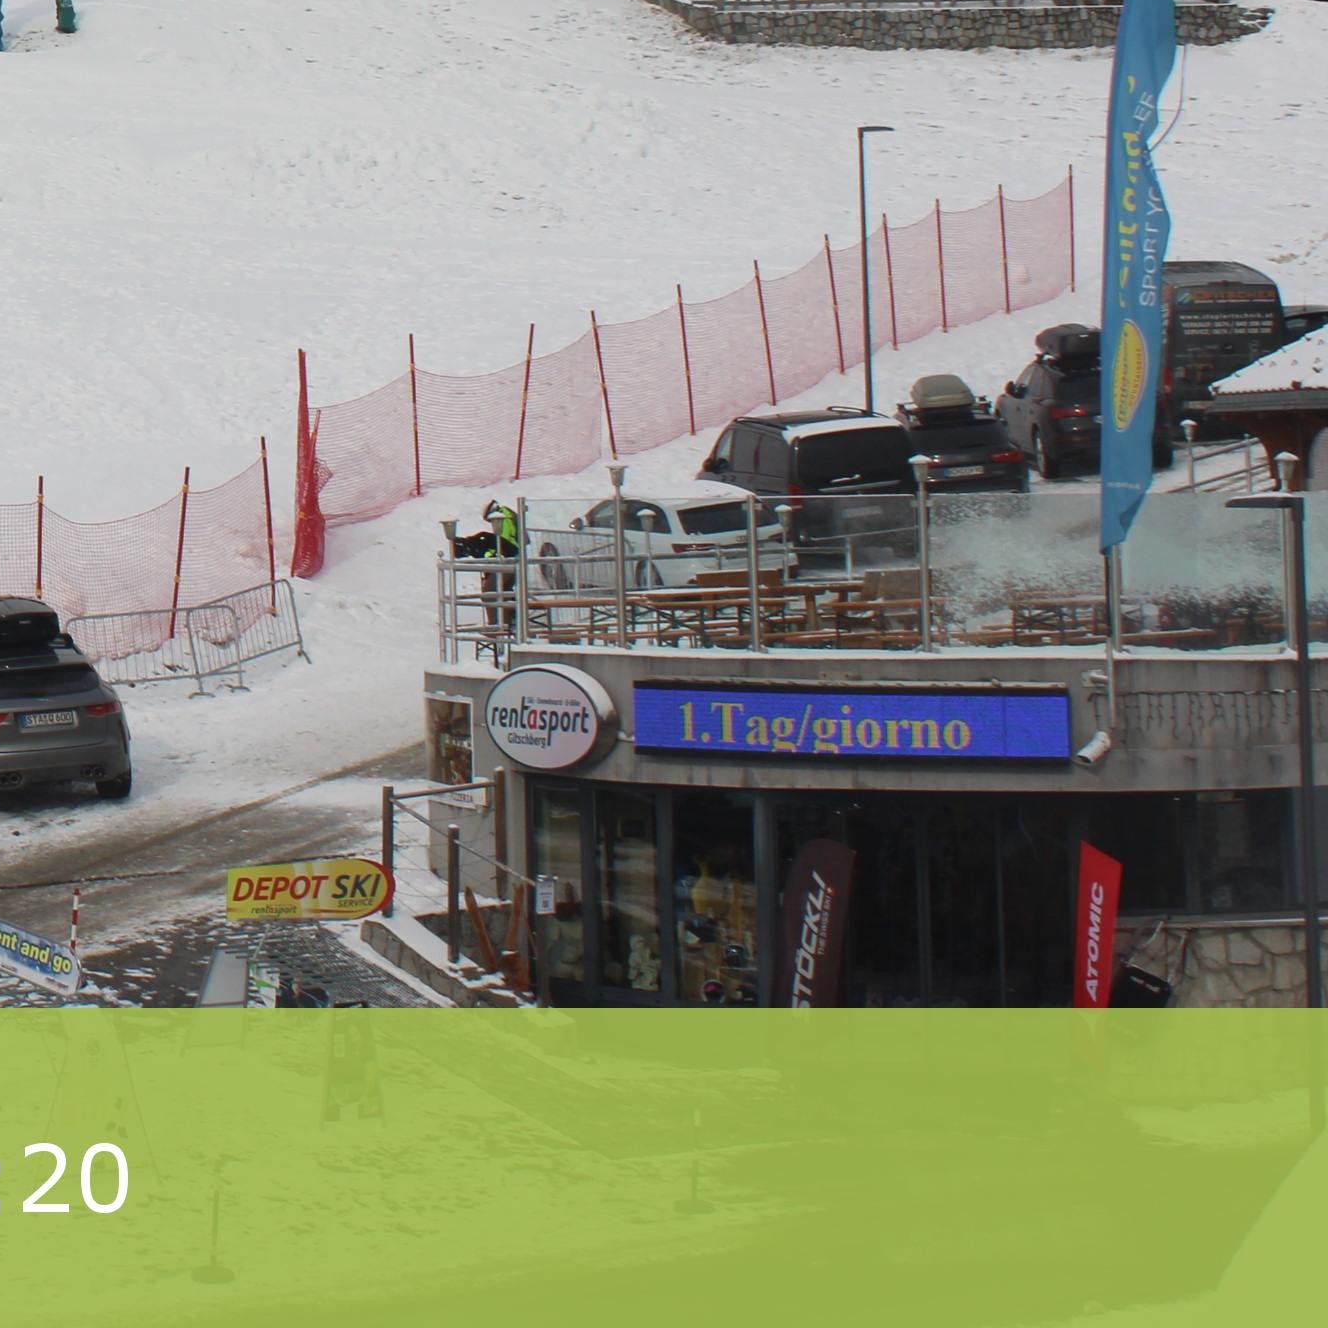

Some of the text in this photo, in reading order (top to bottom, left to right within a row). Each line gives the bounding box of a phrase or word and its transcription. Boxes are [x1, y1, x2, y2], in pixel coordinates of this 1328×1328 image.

[1139, 223, 1159, 307] SPORT
[491, 696, 589, 746] rentasport
[507, 732, 546, 749] Gitschberg
[679, 701, 972, 755] 1.Tag/giorno
[232, 873, 382, 902] DEPOT SKI
[337, 898, 375, 908] SERVICE
[251, 903, 297, 916] rentasport
[19, 940, 51, 965] and
[52, 954, 73, 974] go
[792, 870, 827, 1013] STÖCKLI
[1085, 881, 1104, 1003] ATOMIC
